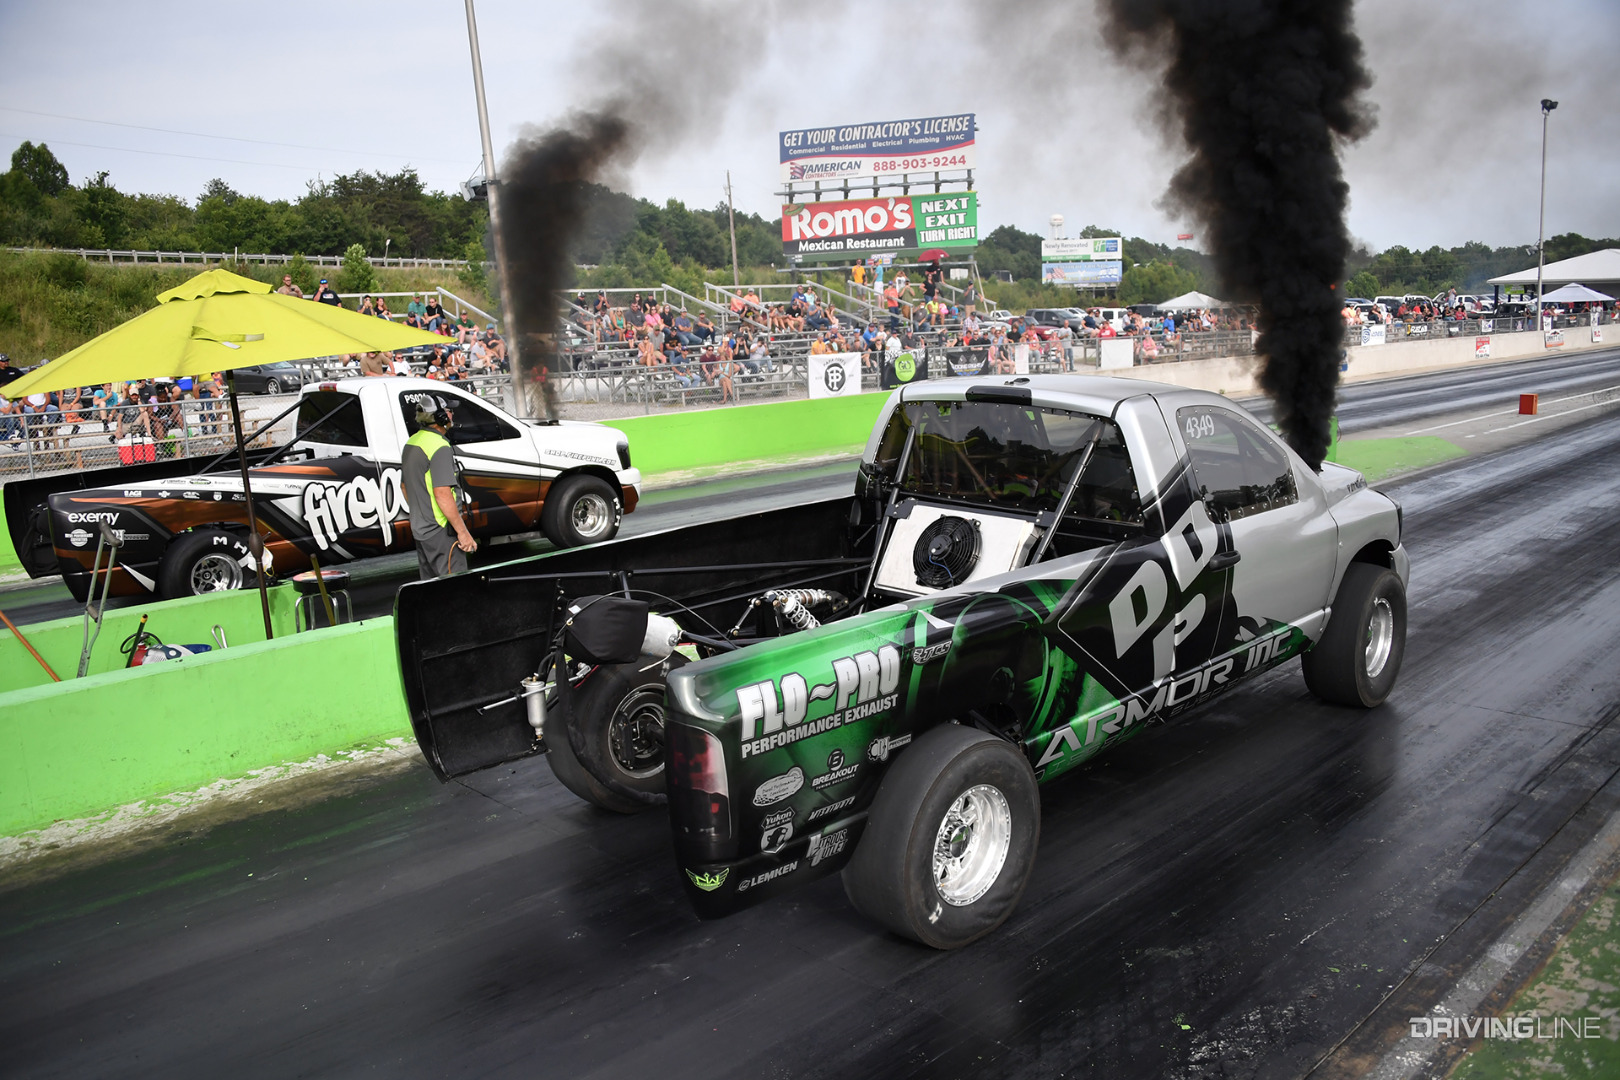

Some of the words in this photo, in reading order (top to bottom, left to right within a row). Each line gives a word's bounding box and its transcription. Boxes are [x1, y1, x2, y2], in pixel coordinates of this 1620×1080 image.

[783, 131, 804, 147] GET
[806, 129, 836, 145] YOUR
[923, 116, 970, 134] LICENSE
[788, 146, 826, 155] Commercial
[830, 142, 867, 151] Residential
[872, 139, 903, 148] Electrical
[908, 137, 940, 145] Plumbing
[806, 160, 862, 174] AMERICAN
[873, 155, 967, 172] 888-903-9244
[921, 197, 970, 213] NEXT
[925, 212, 967, 228] EXIT
[919, 229, 947, 243] TURN
[947, 225, 976, 241] RIGHT
[798, 240, 844, 252] Mexican
[846, 236, 905, 249] Restaurant
[1186, 414, 1215, 439] 4349
[1035, 657, 1234, 768] ARMOR
[741, 713, 842, 759] PERFORMANCE
[844, 694, 899, 724] EXHAUST
[812, 763, 860, 787] BREAKOUT
[766, 811, 792, 824] Yukon
[751, 861, 798, 887] LEMKEN
